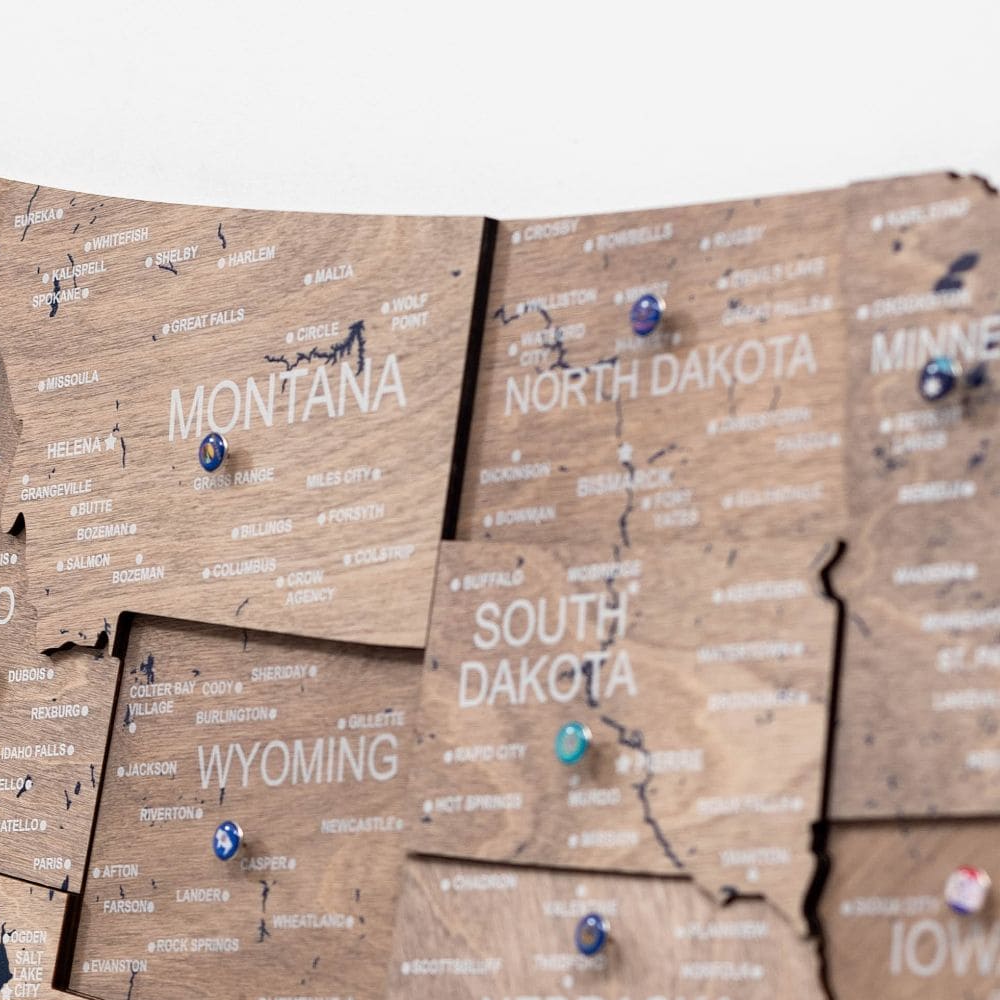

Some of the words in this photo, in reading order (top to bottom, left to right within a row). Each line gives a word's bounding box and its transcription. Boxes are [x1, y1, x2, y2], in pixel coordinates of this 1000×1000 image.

[14, 209, 56, 228] EUREKA
[92, 228, 149, 249] WHITEFISH
[155, 245, 199, 265] SHELBY
[228, 246, 275, 266] HARLEM
[52, 261, 107, 281] KALISPELL
[32, 288, 81, 308] SPOKANE
[171, 313, 208, 333] GREAT
[210, 308, 245, 325] FALLS
[296, 322, 340, 341] CIRCLE
[46, 370, 99, 390] MISSOULA
[504, 360, 640, 416] NORTH
[650, 332, 819, 398] DAKOTA
[168, 353, 407, 442] MONTANA
[47, 437, 101, 459] HELENA
[21, 480, 92, 500] GRANGEVILLE
[78, 499, 113, 516] BUTTE
[77, 523, 129, 541] BOZEMAN
[240, 519, 292, 537] BILLINGS
[67, 554, 110, 571] SALMON
[112, 567, 165, 584] BOZEMAN
[473, 591, 628, 649] SOUTH
[8, 669, 46, 683] DUBOIS
[458, 649, 638, 708] DAKOTA
[130, 683, 171, 699] COLTER
[175, 681, 196, 695] BAY
[202, 681, 233, 696] CODY
[31, 704, 80, 720] REXBURG
[128, 701, 174, 716] VILLAGE
[196, 707, 269, 725] BURLINGTON
[1, 745, 33, 760] IDAHO
[35, 743, 66, 757] FALLS
[125, 761, 177, 777] JACKSON
[197, 732, 400, 790] WYOMING
[140, 806, 194, 822] RIVERTON
[34, 858, 63, 870] PARIS
[103, 864, 139, 878] AFTON
[176, 889, 221, 903] LANDER
[104, 900, 147, 913] FARSON
[157, 939, 187, 952] ROCK
[189, 939, 239, 952] SPRINGS
[889, 919, 1000, 977] IOW
[15, 951, 43, 964] SALT
[91, 959, 147, 973] EVANSTON
[14, 968, 42, 981] LAKE
[15, 984, 40, 997] CITY
